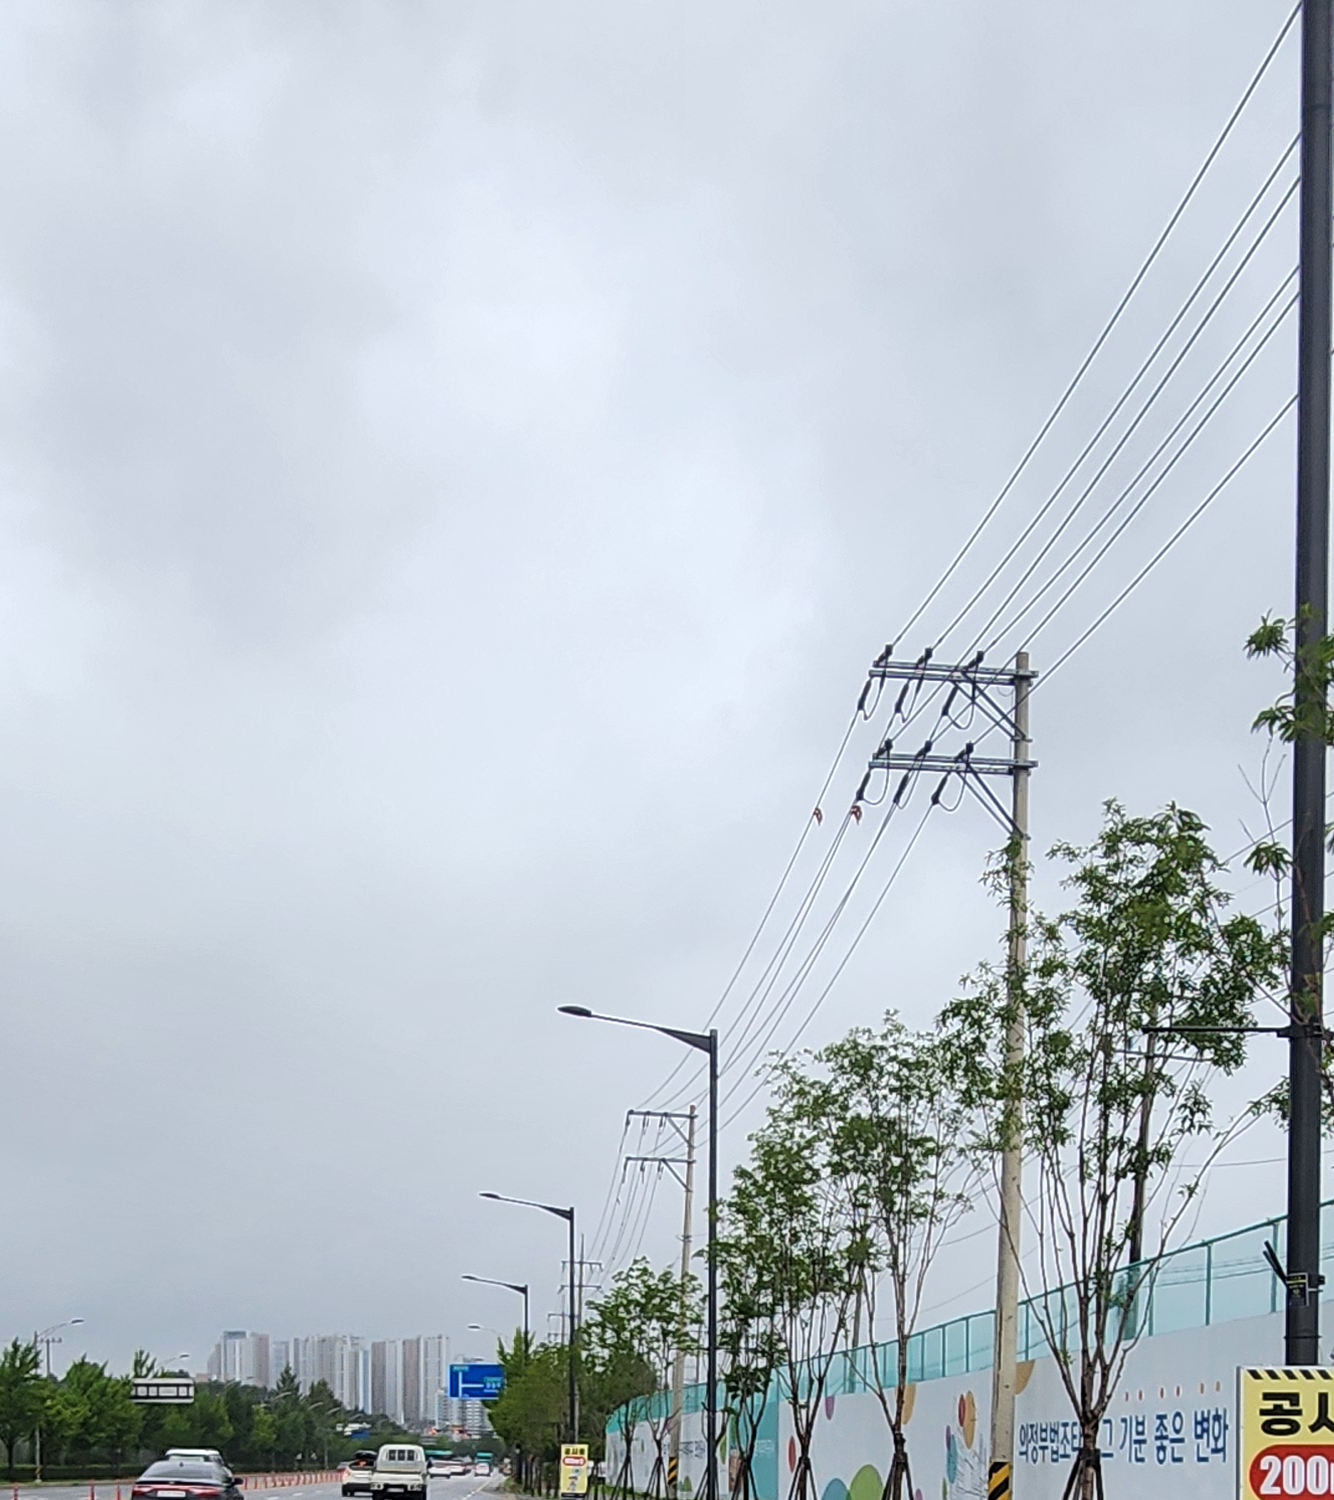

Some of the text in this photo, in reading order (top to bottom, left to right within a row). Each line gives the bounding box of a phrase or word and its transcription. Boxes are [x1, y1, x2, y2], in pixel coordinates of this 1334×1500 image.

[1019, 1420, 1085, 1464] 의정부법조타
[1119, 1414, 1147, 1463] 기분
[1154, 1411, 1185, 1465] 좋은
[1194, 1407, 1229, 1463] 변화
